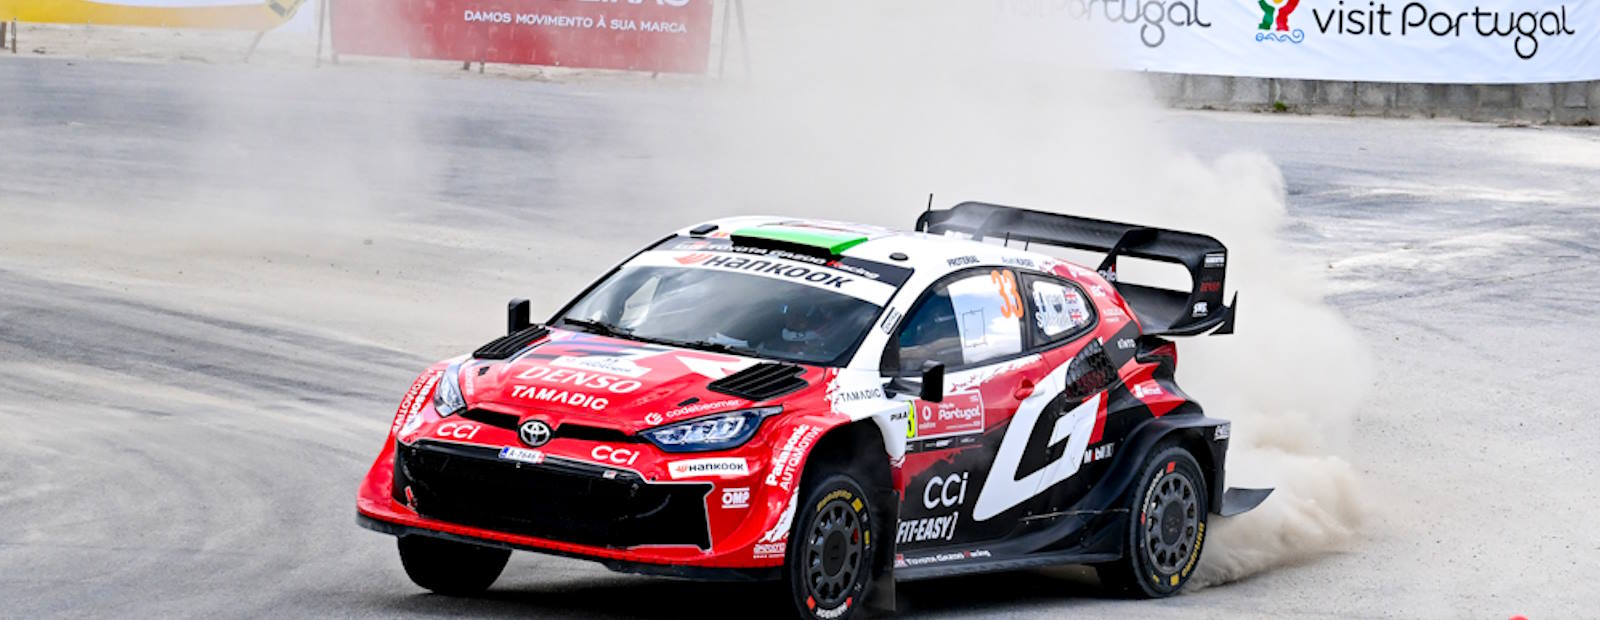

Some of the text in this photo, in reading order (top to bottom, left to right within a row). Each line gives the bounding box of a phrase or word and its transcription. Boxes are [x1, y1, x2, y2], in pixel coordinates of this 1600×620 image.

[464, 10, 688, 33] DAMOS MOVIMENTO À SUA MARCA
[1312, 0, 1575, 59] visit Portugal
[991, 269, 1024, 319] 33
[516, 366, 643, 394] DENSO
[511, 385, 609, 411] TAMADIC
[840, 388, 882, 402] TAMADIC
[938, 406, 981, 420] Portugal
[765, 423, 810, 486] Panasonic
[779, 425, 823, 493] AUTOMOTIVE
[722, 491, 749, 505] OMP
